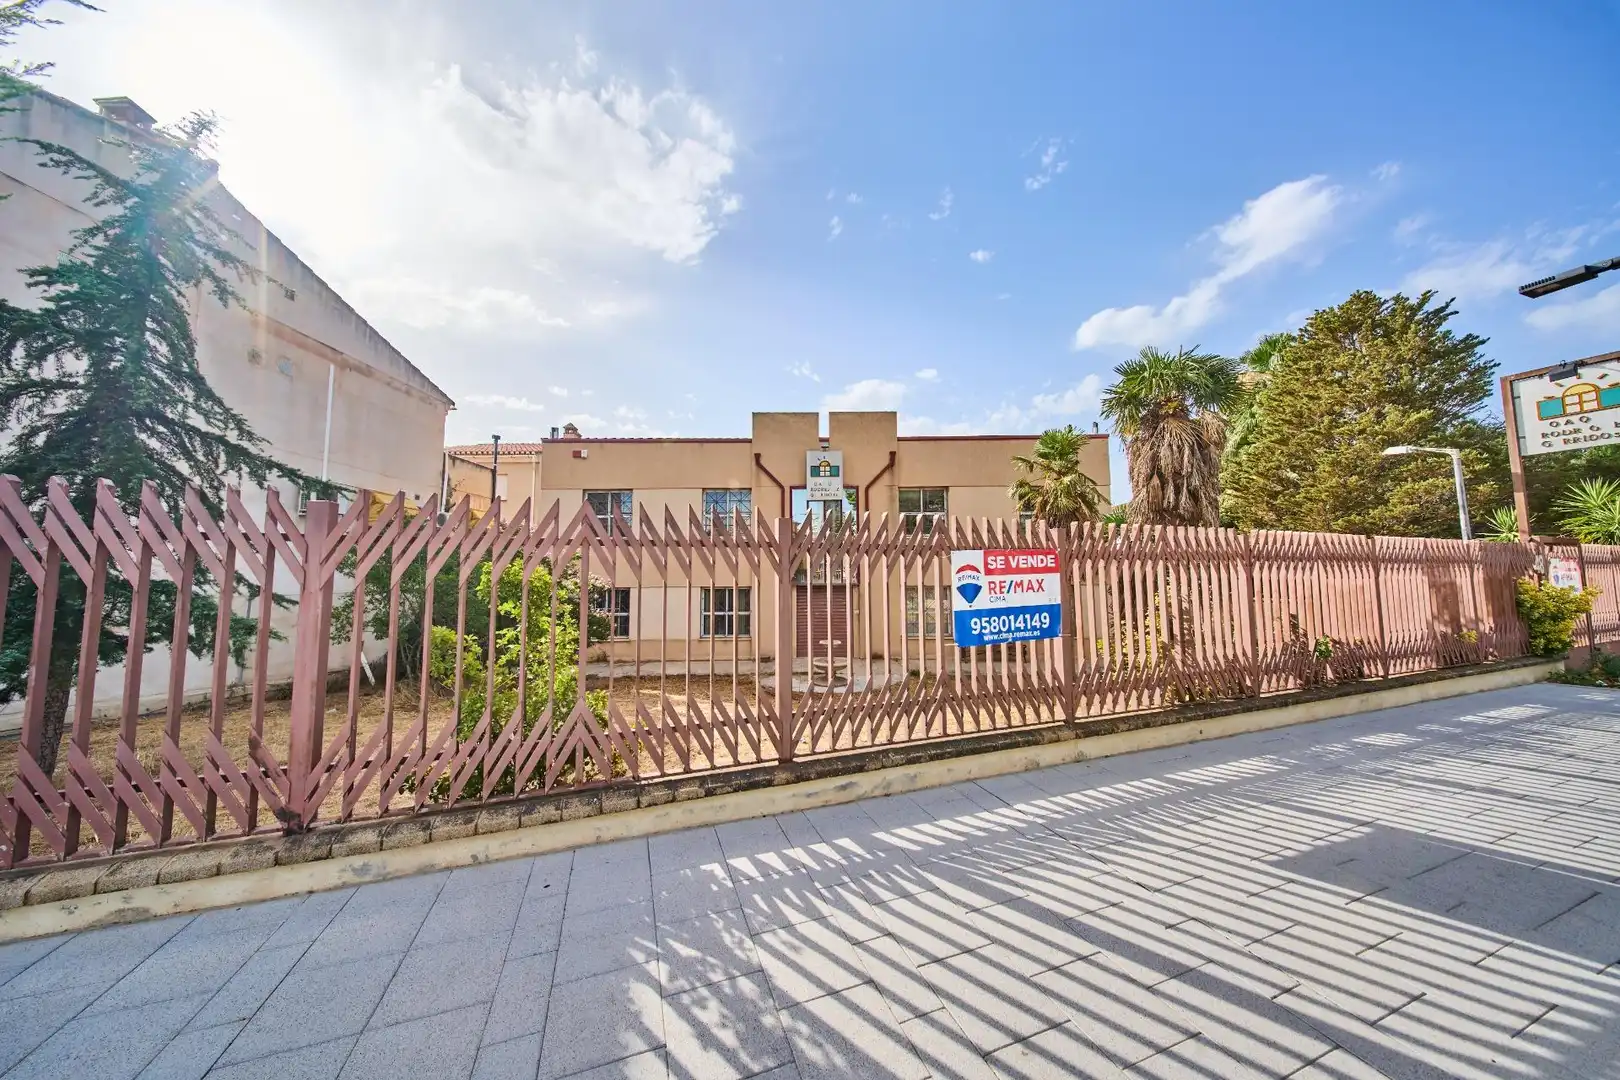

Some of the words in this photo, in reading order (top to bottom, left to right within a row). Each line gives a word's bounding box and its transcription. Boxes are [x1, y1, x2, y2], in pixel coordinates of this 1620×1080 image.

[987, 555, 1006, 569] SE
[1008, 554, 1056, 569] VENDE
[987, 578, 1046, 595] RE/MAX
[988, 595, 1007, 603] CIMA
[970, 612, 1050, 635] 958014149
